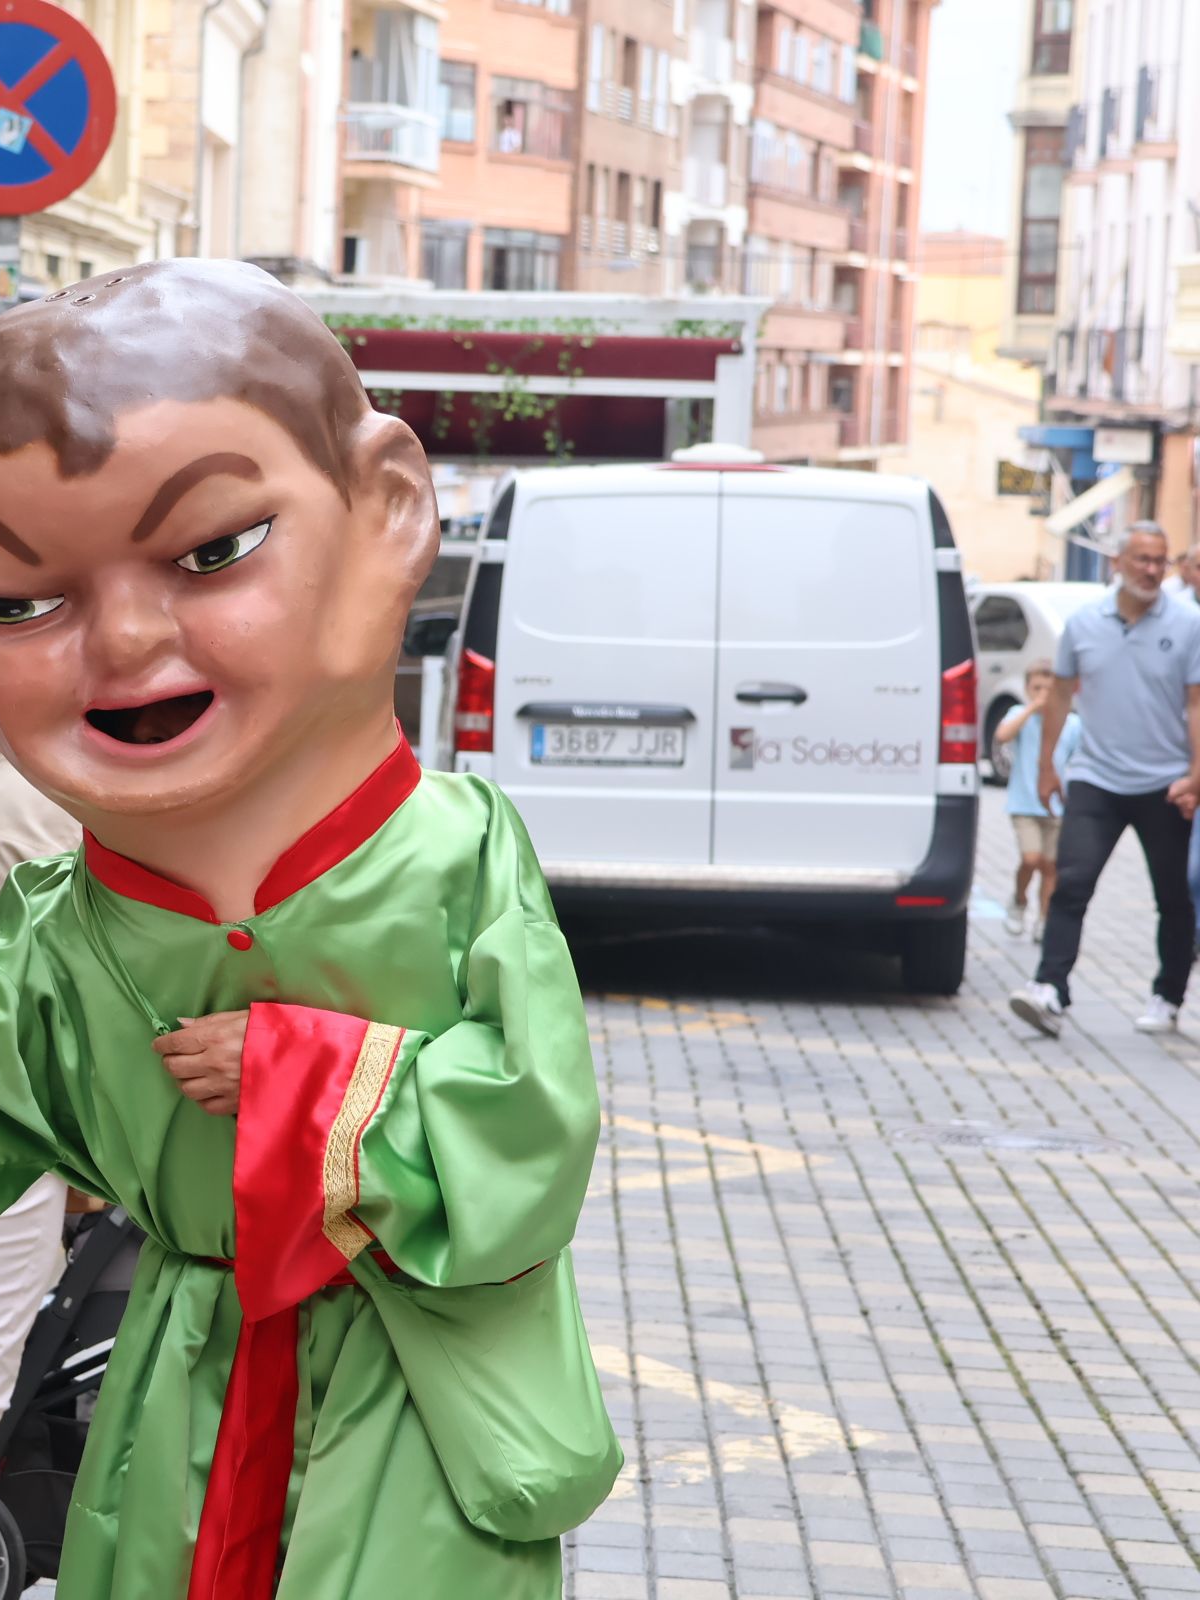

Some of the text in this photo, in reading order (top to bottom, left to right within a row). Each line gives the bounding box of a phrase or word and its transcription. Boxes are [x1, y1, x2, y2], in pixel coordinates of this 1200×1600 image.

[551, 729, 677, 755] 3687 JJR
[791, 736, 922, 767] Soledad
